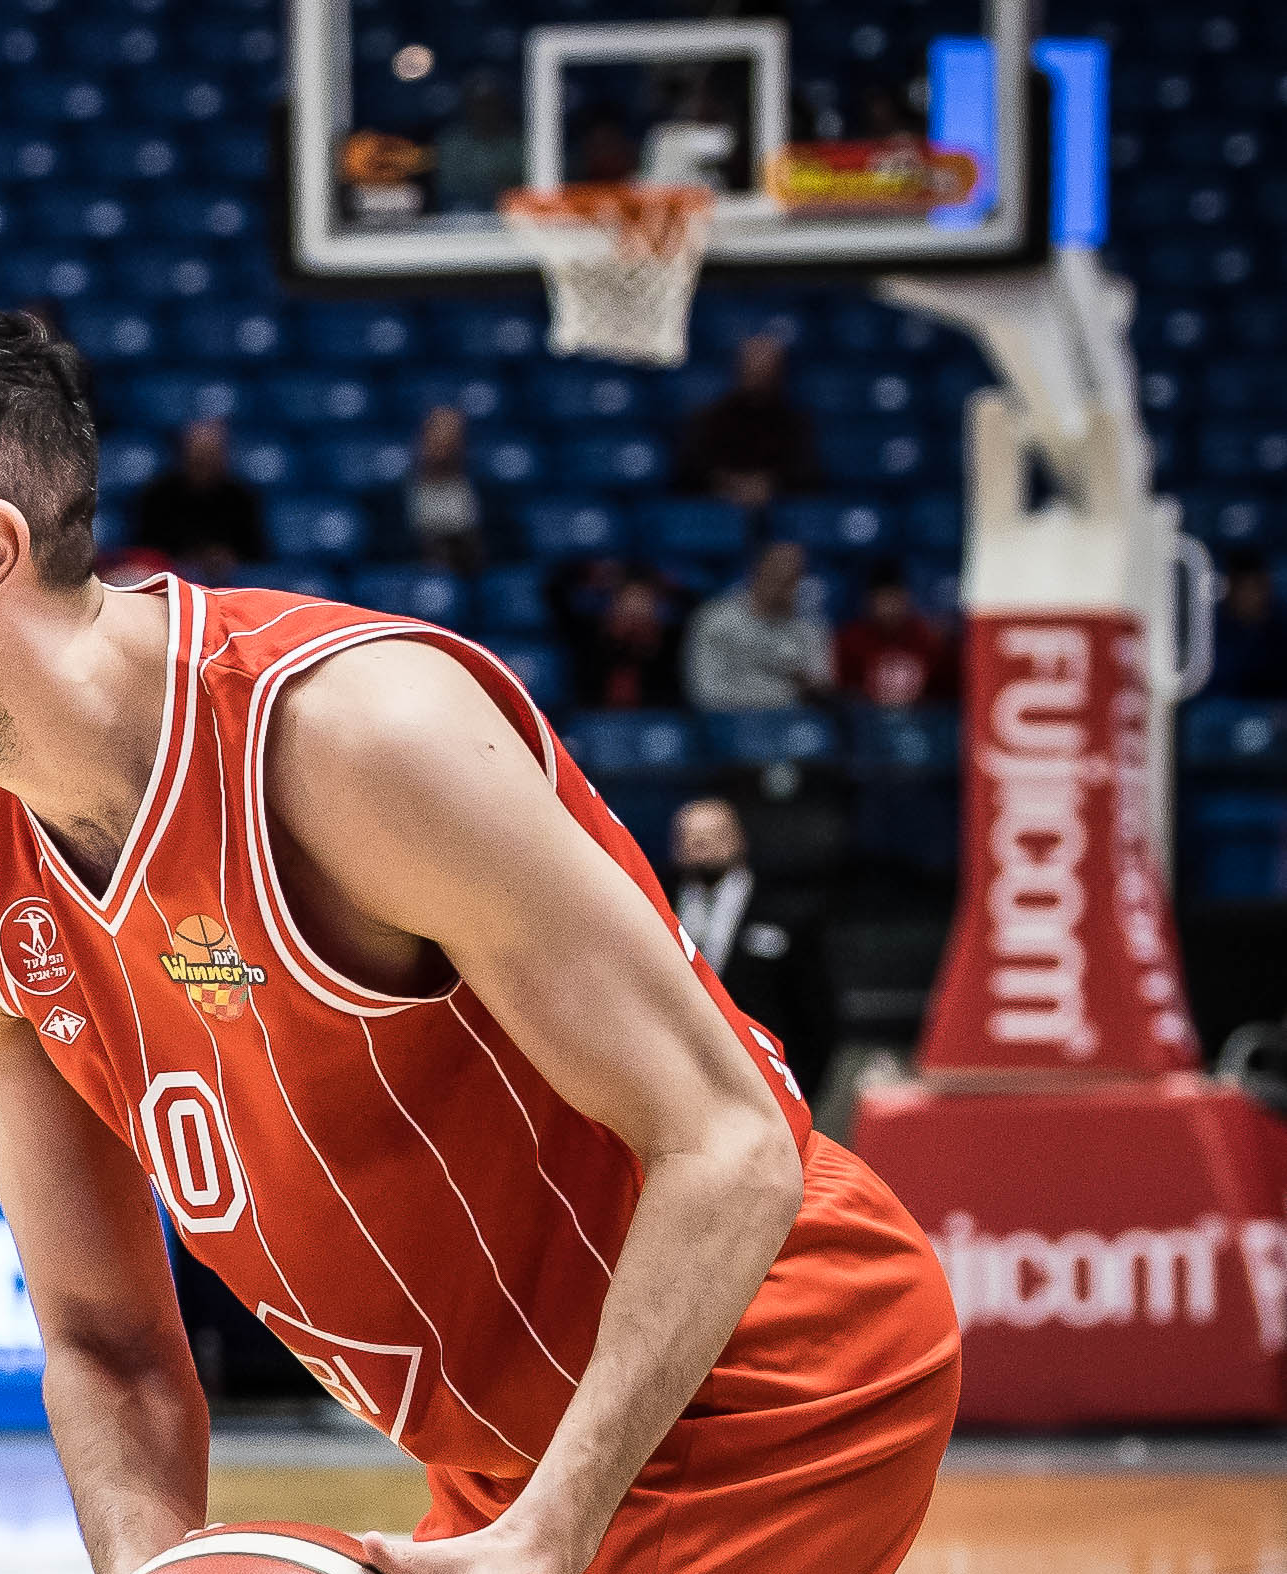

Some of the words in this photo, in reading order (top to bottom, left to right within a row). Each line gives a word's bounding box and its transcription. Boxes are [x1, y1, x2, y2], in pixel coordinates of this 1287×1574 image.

[160, 954, 243, 983] Winner
[242, 960, 266, 983] סל
[139, 1071, 248, 1235] 0
